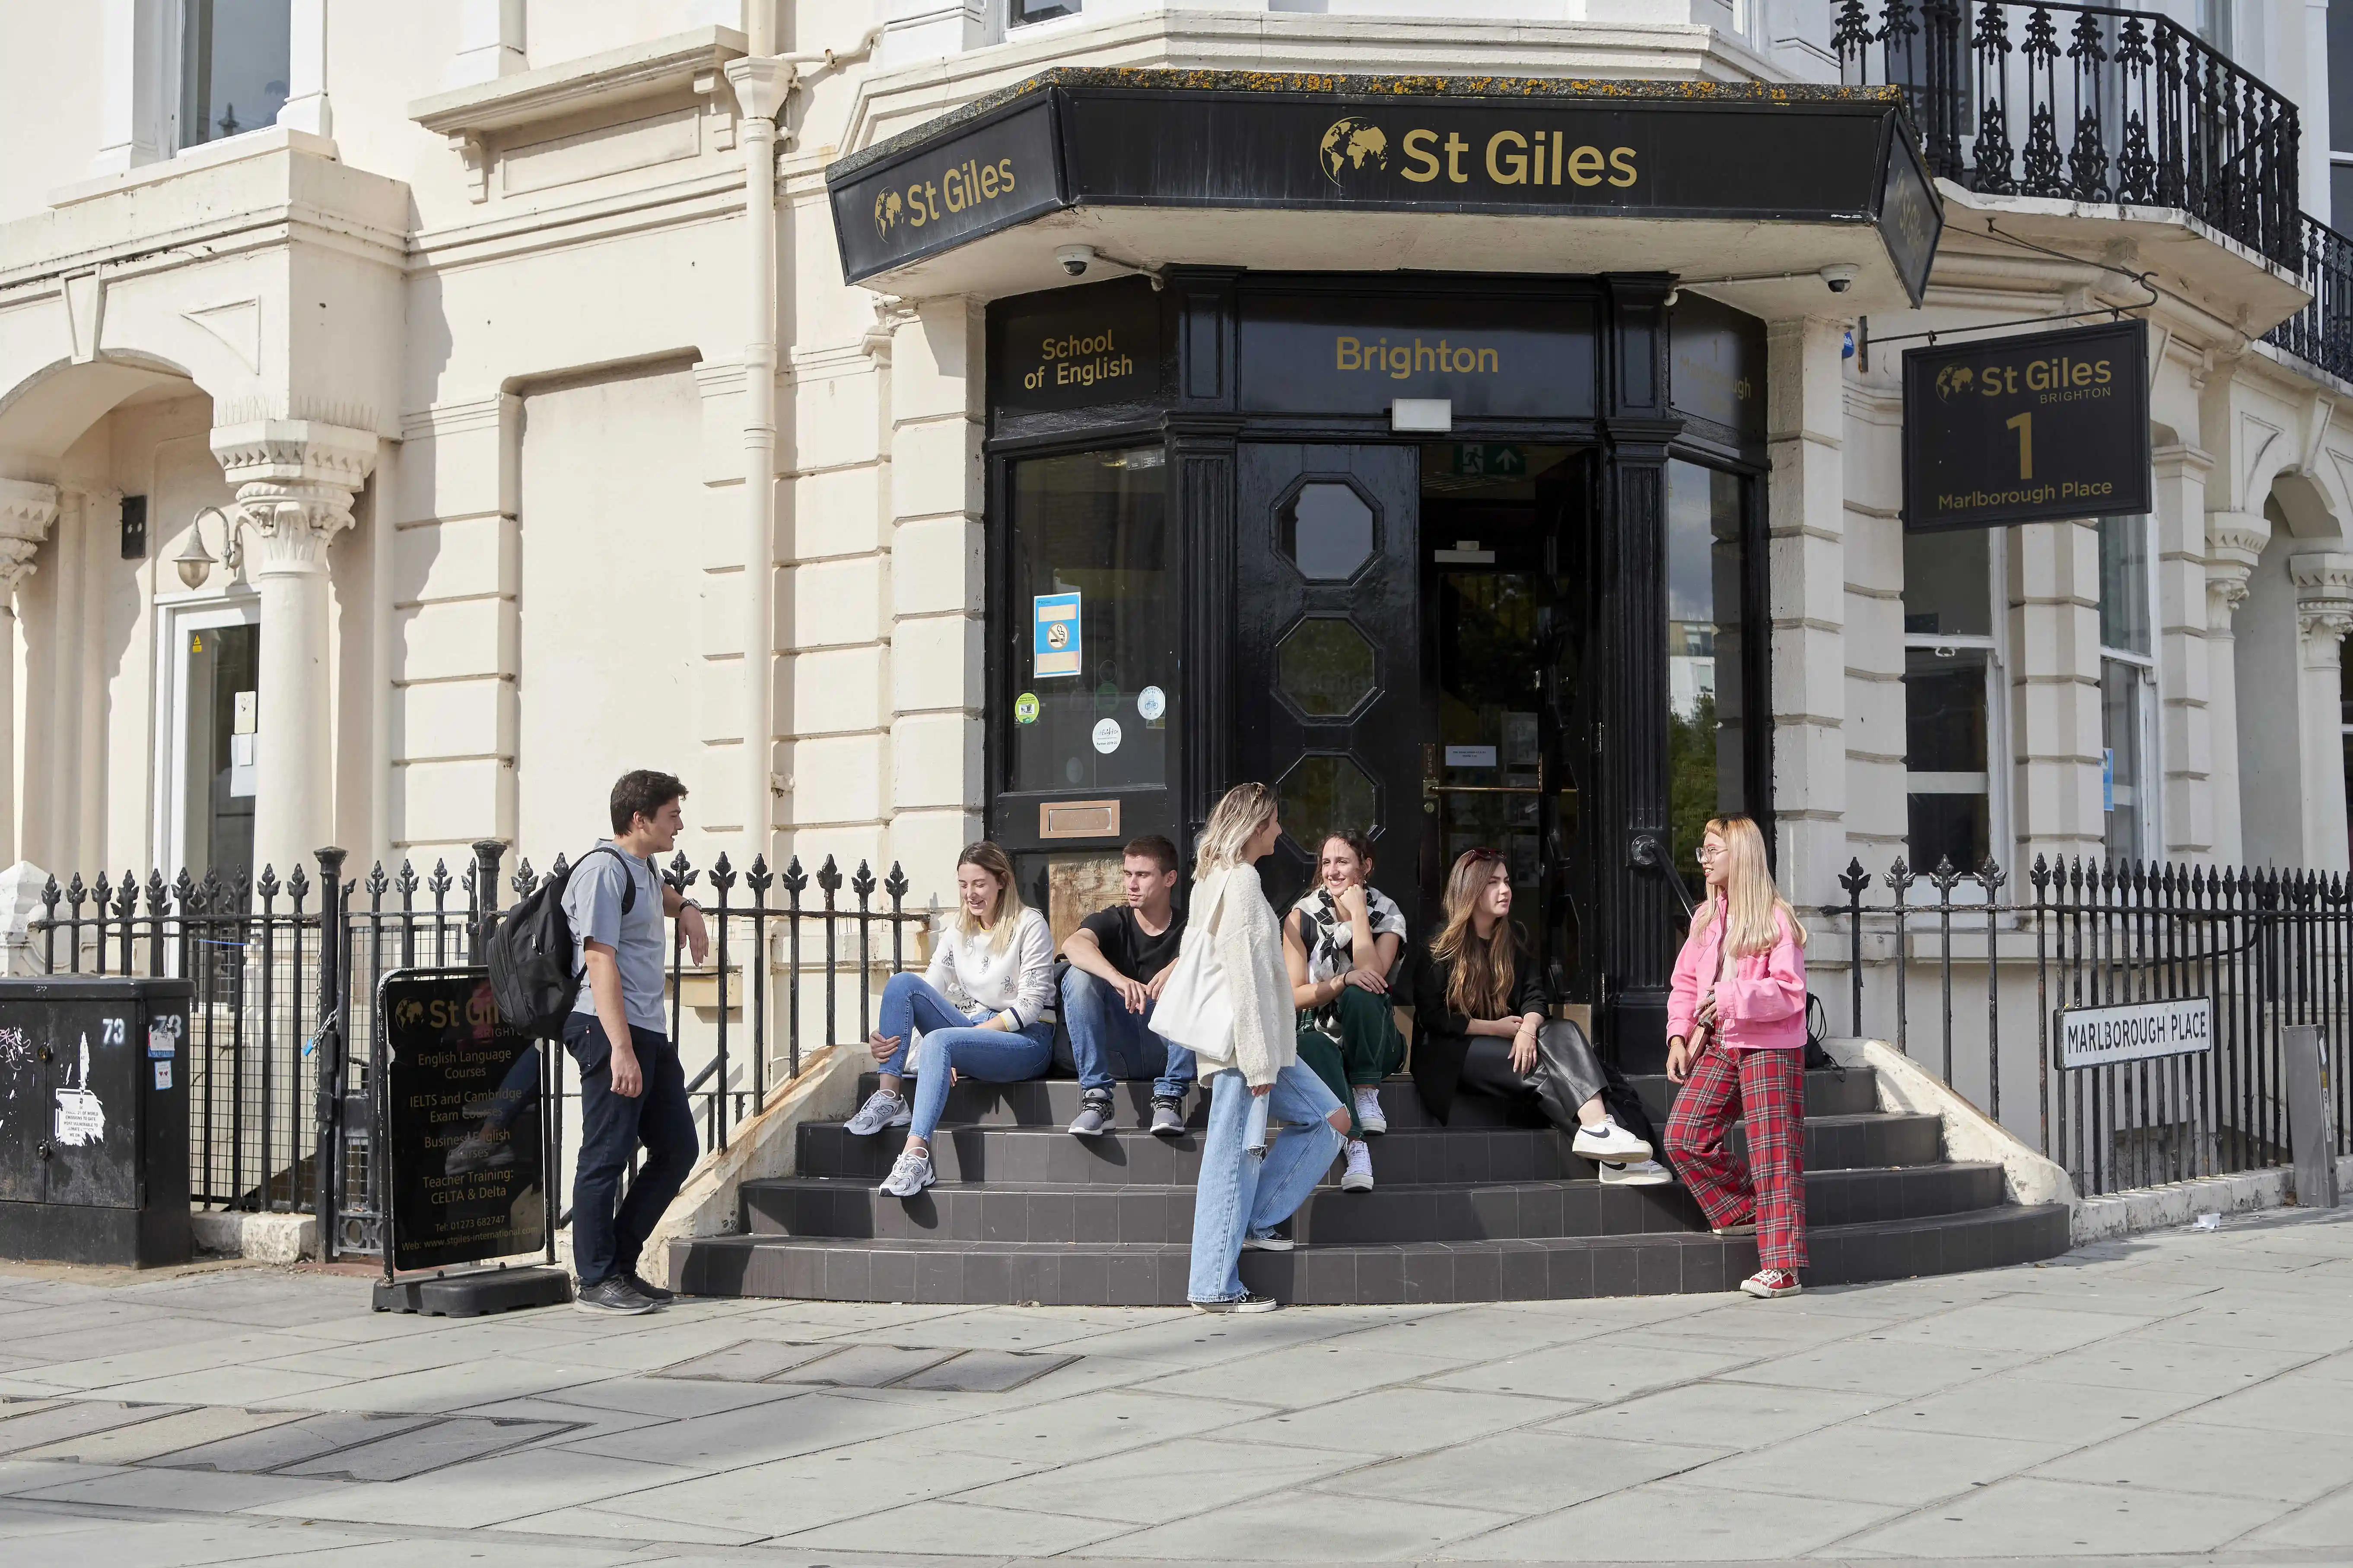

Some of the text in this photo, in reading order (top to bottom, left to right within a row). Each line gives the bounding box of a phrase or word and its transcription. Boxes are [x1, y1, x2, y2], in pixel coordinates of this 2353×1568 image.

[1400, 129, 1638, 187] St Giles
[907, 158, 1015, 226] St Giles
[1042, 329, 1114, 360] School
[1336, 336, 1498, 380] Brighton
[1024, 354, 1132, 389] of English
[1981, 357, 2112, 396] St Giles
[2040, 387, 2111, 404] BRIGHTON
[2006, 411, 2032, 480] 1
[1938, 481, 2113, 510] Marlborough Place
[429, 997, 499, 1028] St Gil
[102, 1018, 126, 1045] 73
[478, 1027, 522, 1038] RIGHT
[2068, 1011, 2207, 1054] MARLBOROUGH PLACE
[418, 1050, 512, 1067] English Language
[445, 1067, 486, 1079] Courses
[410, 1088, 522, 1107] IELTS and Cambridge
[877, 1105, 889, 1116] N
[430, 1107, 503, 1123] Exam Courses
[423, 1168, 514, 1188] Teacher Training:
[431, 1185, 506, 1204] CELTA & Delta
[435, 1215, 505, 1232] Tel: 01273 682747
[401, 1226, 538, 1251] Web: www.stgiles-international.com
